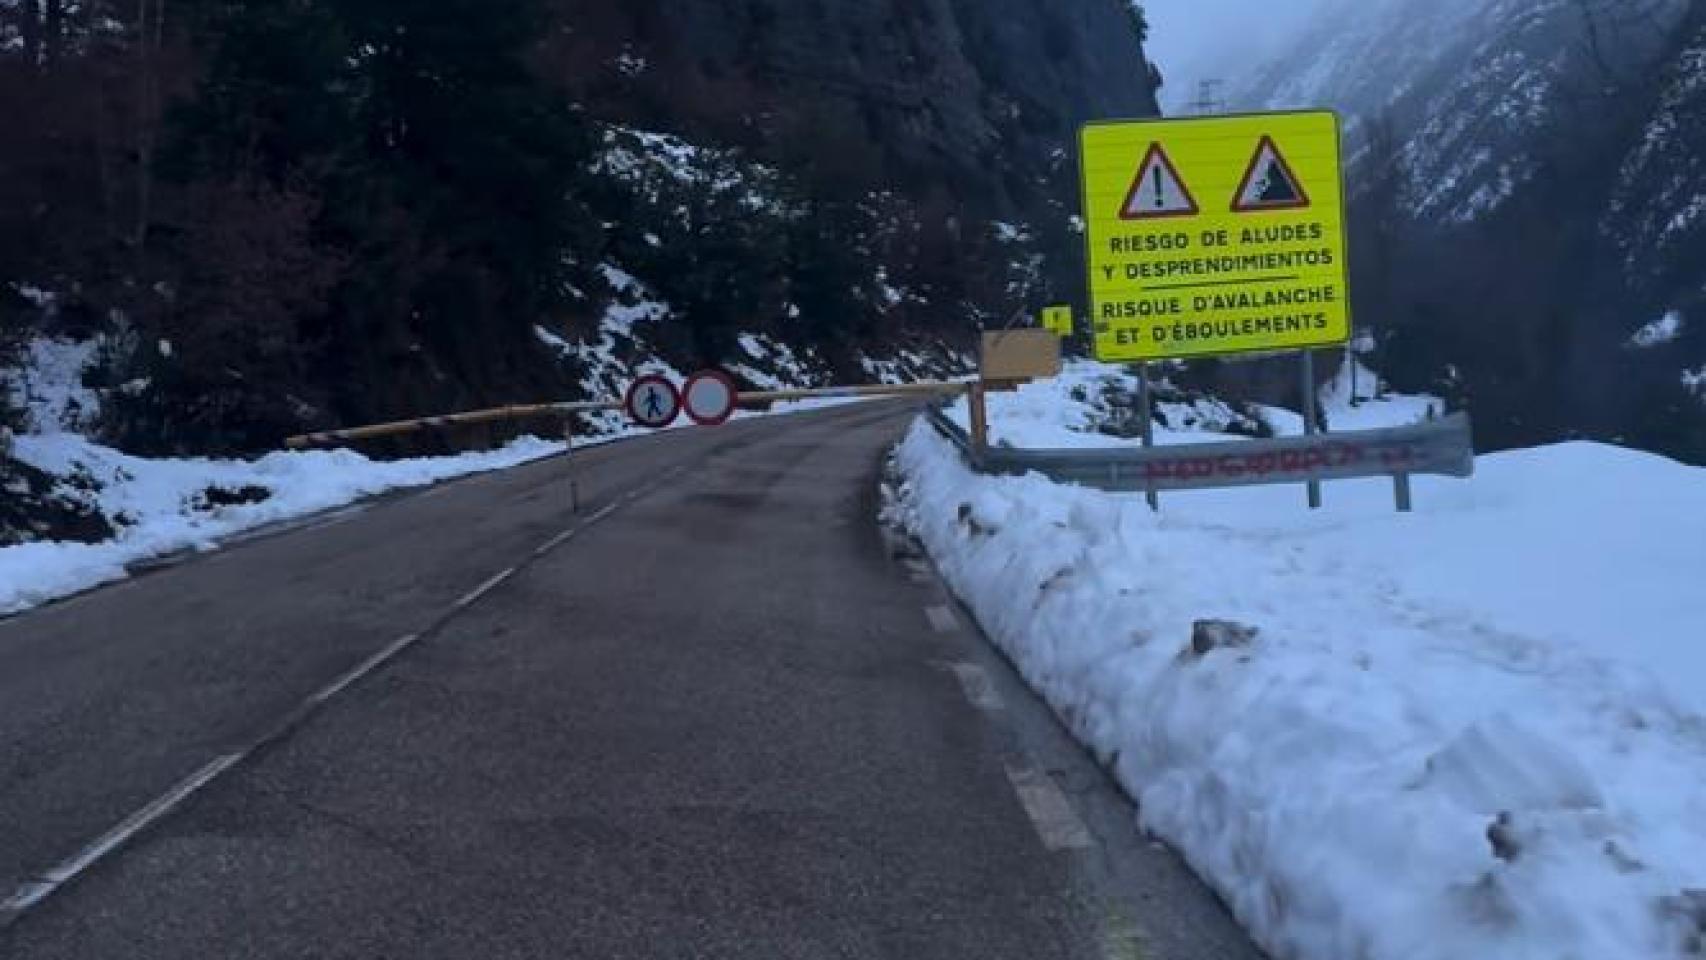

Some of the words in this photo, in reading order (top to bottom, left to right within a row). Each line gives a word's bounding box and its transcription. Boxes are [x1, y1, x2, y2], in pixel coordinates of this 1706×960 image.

[1110, 231, 1189, 253] RIESGO
[1200, 229, 1228, 248] DE
[1240, 222, 1323, 244] ALUDES
[1103, 265, 1115, 281] Y
[1126, 248, 1333, 278] DESPRENDIMIENTOS
[1102, 296, 1181, 318] RISQUE
[1193, 286, 1335, 312] D'AVALANCHE
[1116, 327, 1139, 345] ET
[1152, 312, 1328, 342] D'ÉBOULEMENTS
